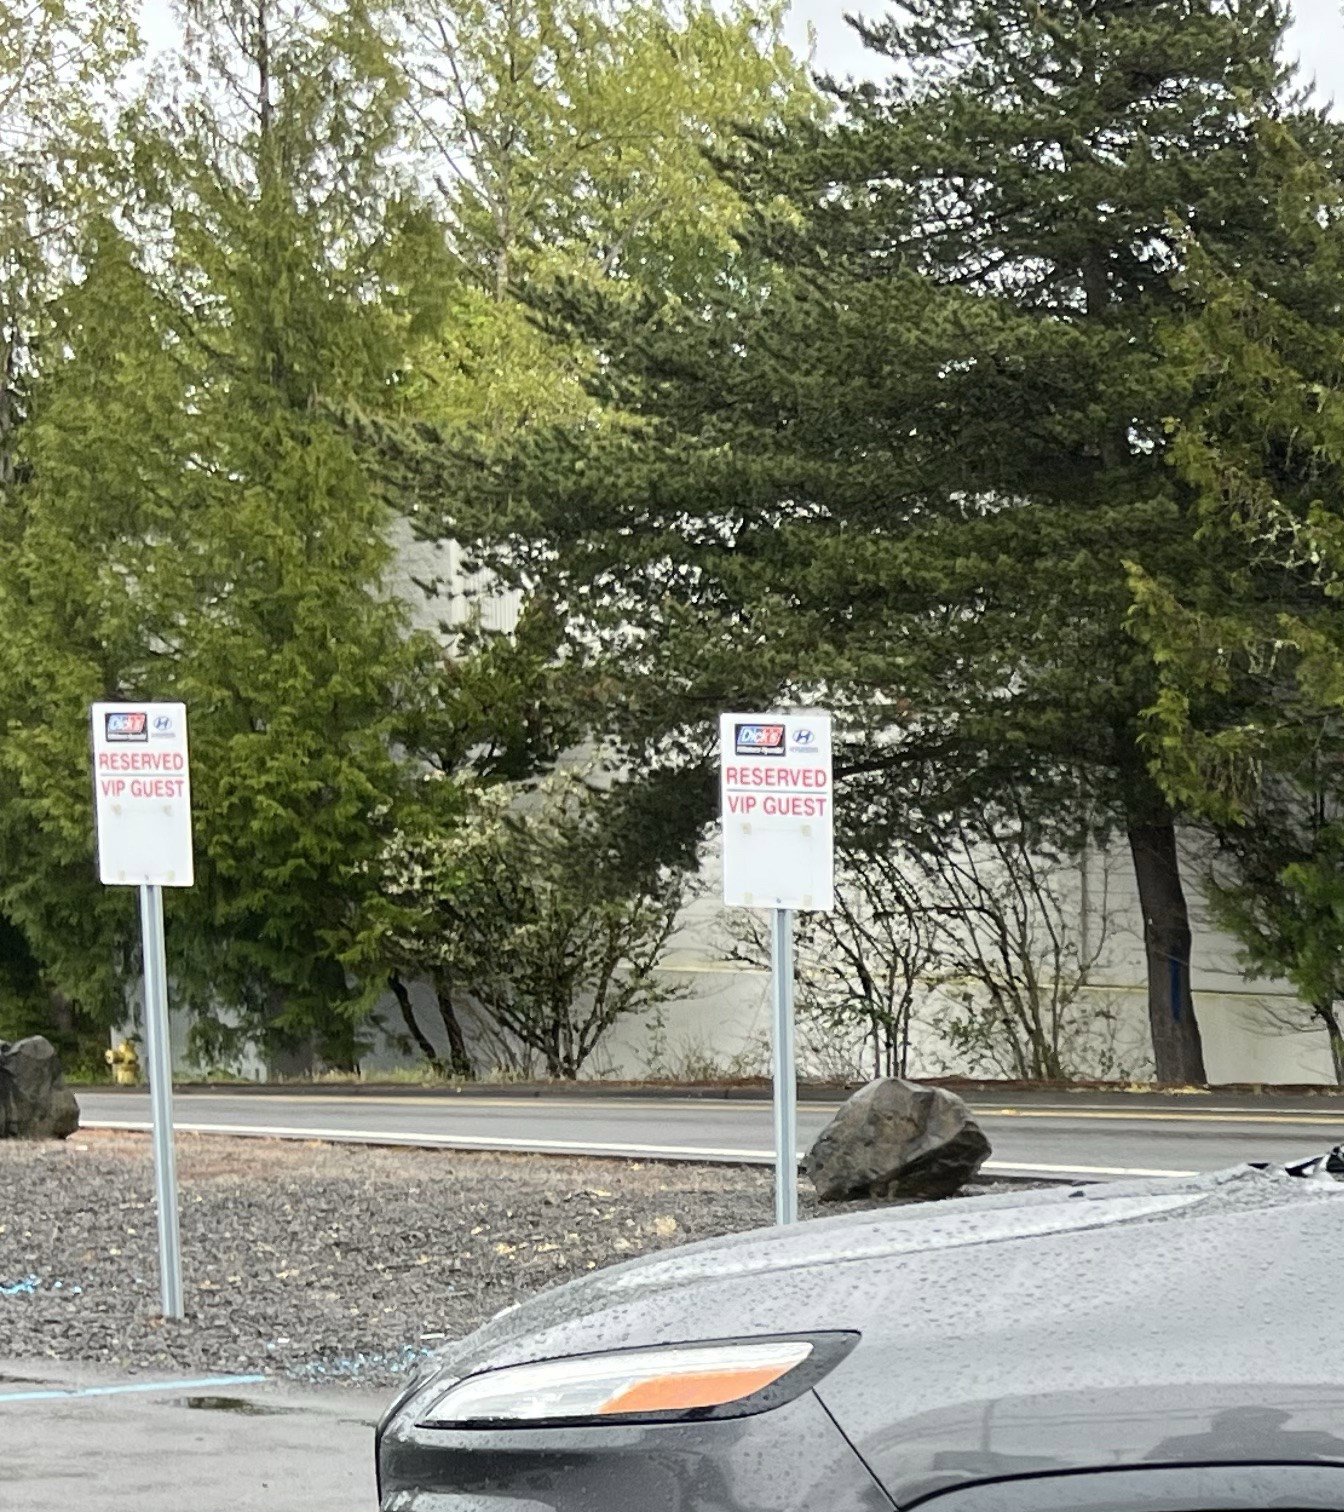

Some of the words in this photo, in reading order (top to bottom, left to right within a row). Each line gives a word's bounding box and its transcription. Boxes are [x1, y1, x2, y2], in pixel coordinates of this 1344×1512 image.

[98, 752, 184, 771] RESERVED
[726, 767, 828, 788] RESERVED
[101, 780, 126, 797] VIP
[130, 779, 185, 798] GUEST
[727, 796, 757, 814] VIP
[762, 796, 827, 817] GUEST
